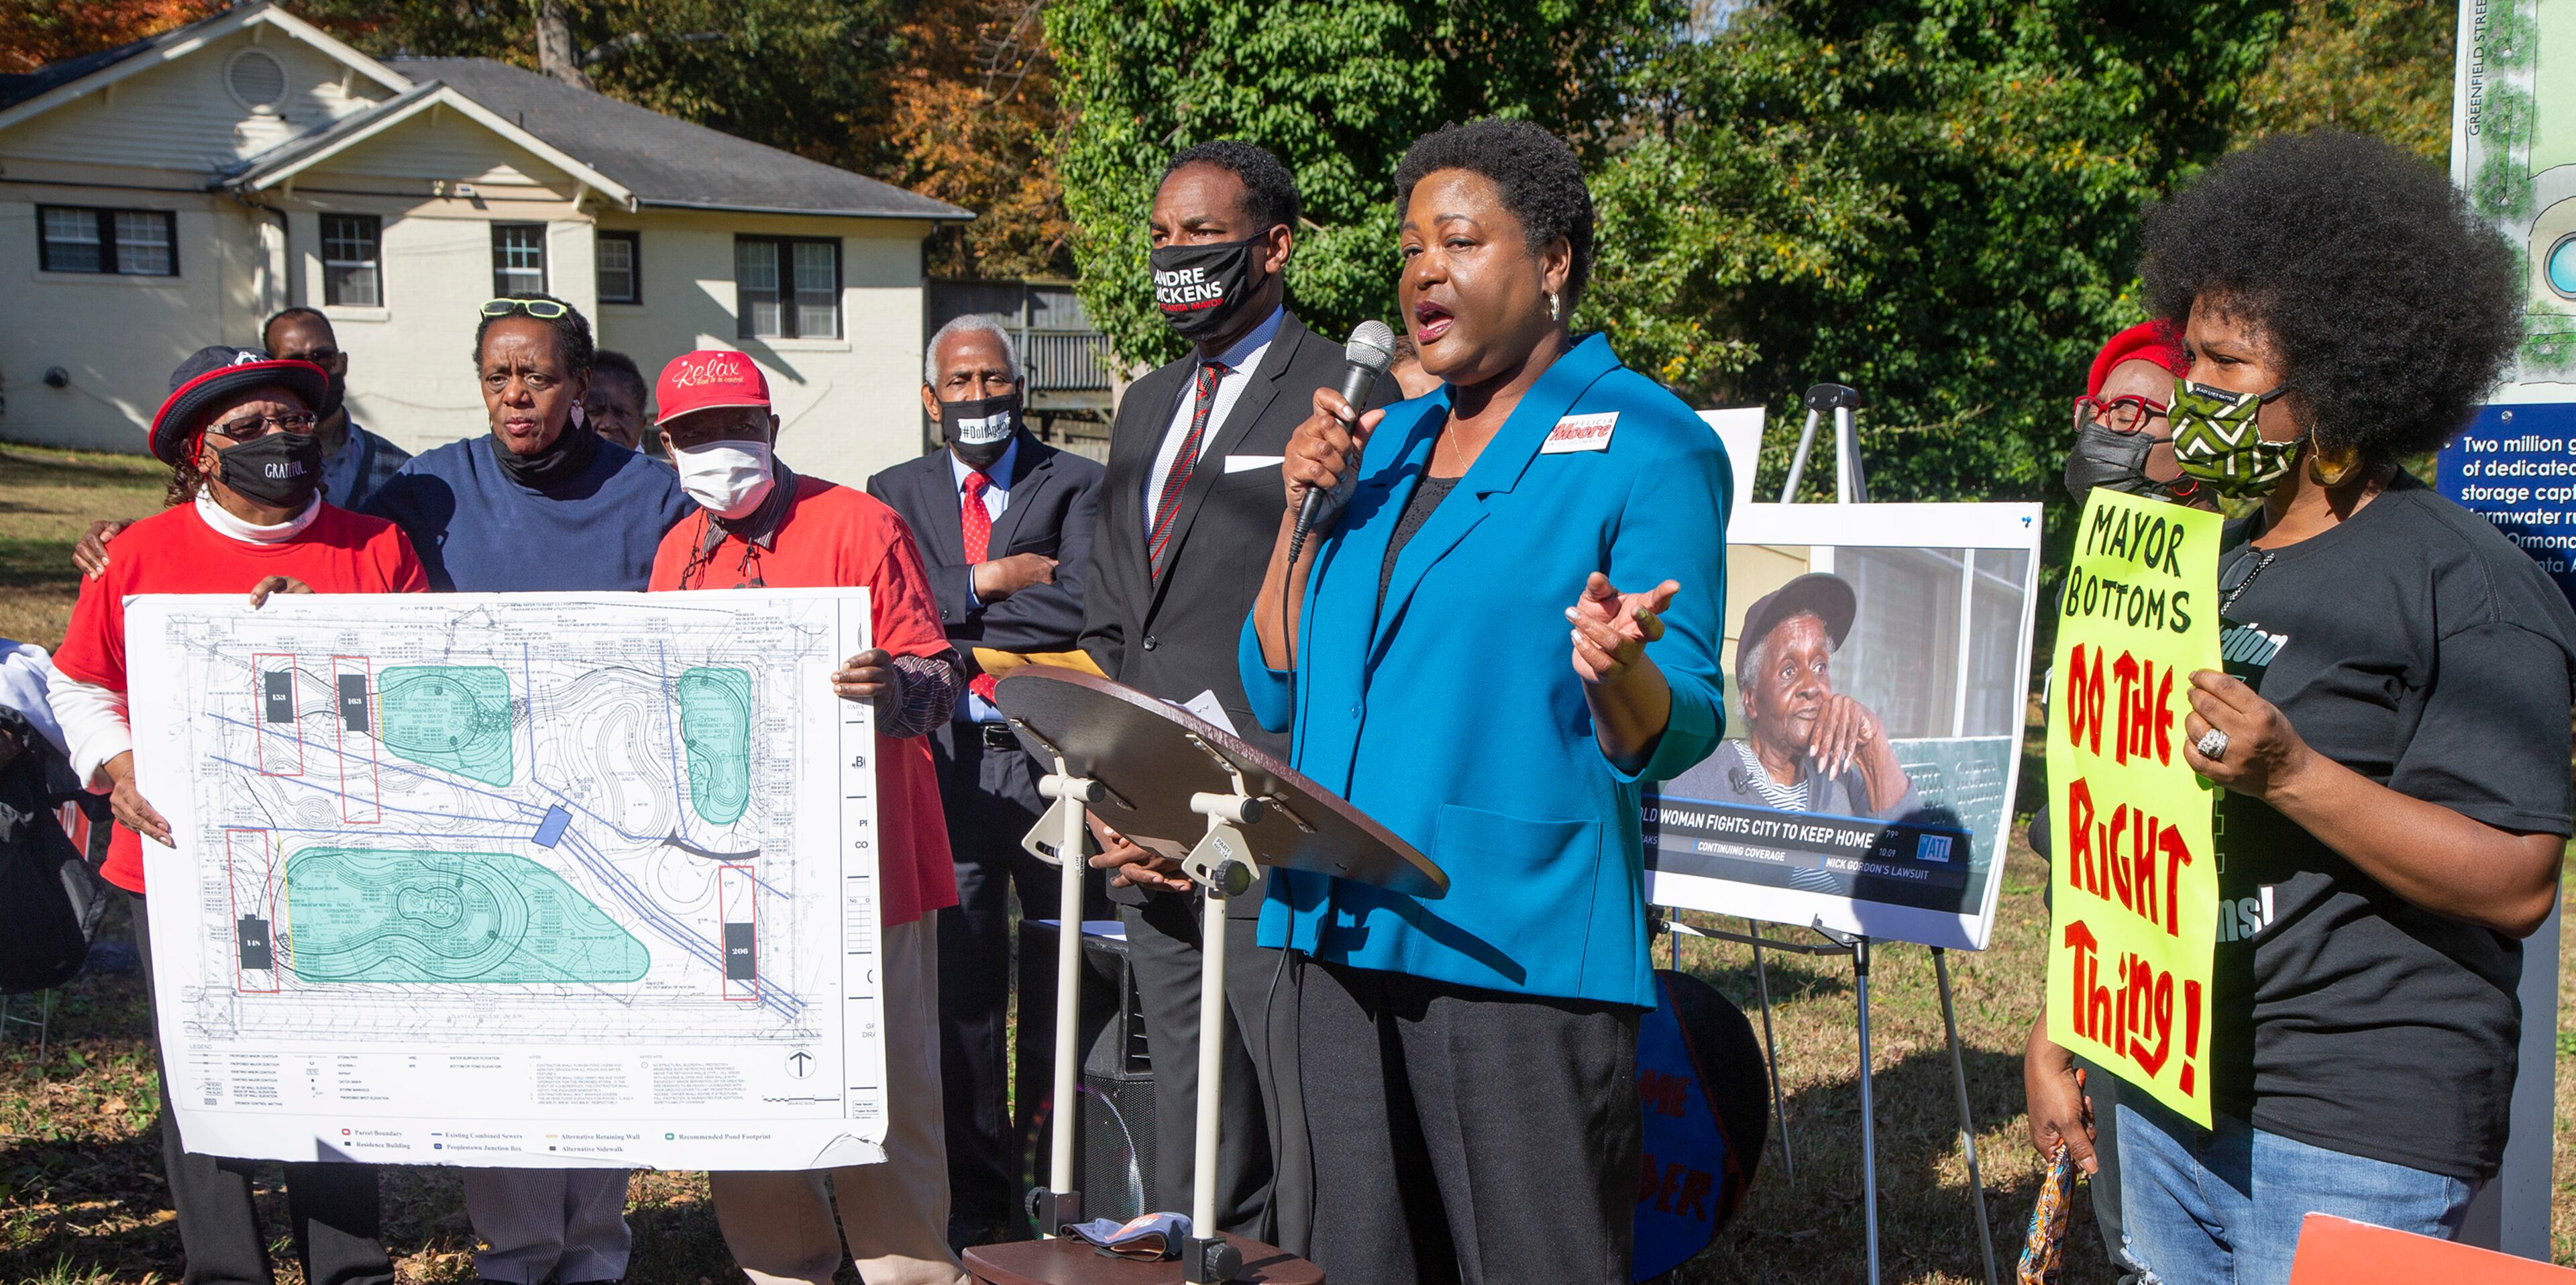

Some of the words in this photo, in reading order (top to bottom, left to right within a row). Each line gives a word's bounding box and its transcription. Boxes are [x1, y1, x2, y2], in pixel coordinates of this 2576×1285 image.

[2469, 46, 2483, 136] GREENFIELD
[1154, 267, 1205, 287] ANDRE
[1191, 297, 1224, 311] MAYOR
[672, 358, 739, 389] Relax
[962, 419, 1008, 439] #DoItAgain
[1548, 423, 1612, 442] Moore
[2463, 436, 2498, 452] Two
[2504, 435, 2563, 452] million
[2463, 460, 2481, 476] of
[2461, 484, 2530, 504] storage
[2086, 505, 2184, 578] MAYOR
[2065, 566, 2192, 634] BOTTOMS
[2068, 643, 2105, 756] DO
[2113, 650, 2174, 766] THE
[1660, 809, 1705, 828] WOMAN
[1706, 814, 1750, 833] FIGHTS
[1752, 820, 1781, 837] CITY
[1782, 823, 1799, 839] TO
[1799, 826, 1834, 843] KEEP
[1835, 829, 1874, 848] HOME
[1698, 841, 1743, 856] CONTINUING
[1745, 847, 1786, 862] COVERAGE
[1826, 858, 1845, 869] NICK
[1847, 860, 1890, 874] GORDON'S
[1891, 867, 1929, 880] LAWSUIT
[1880, 847, 1896, 857] 10:09
[1927, 839, 1948, 858] ATL
[2069, 776, 2192, 937] RIGHT
[2065, 919, 2201, 1097] Thing!
